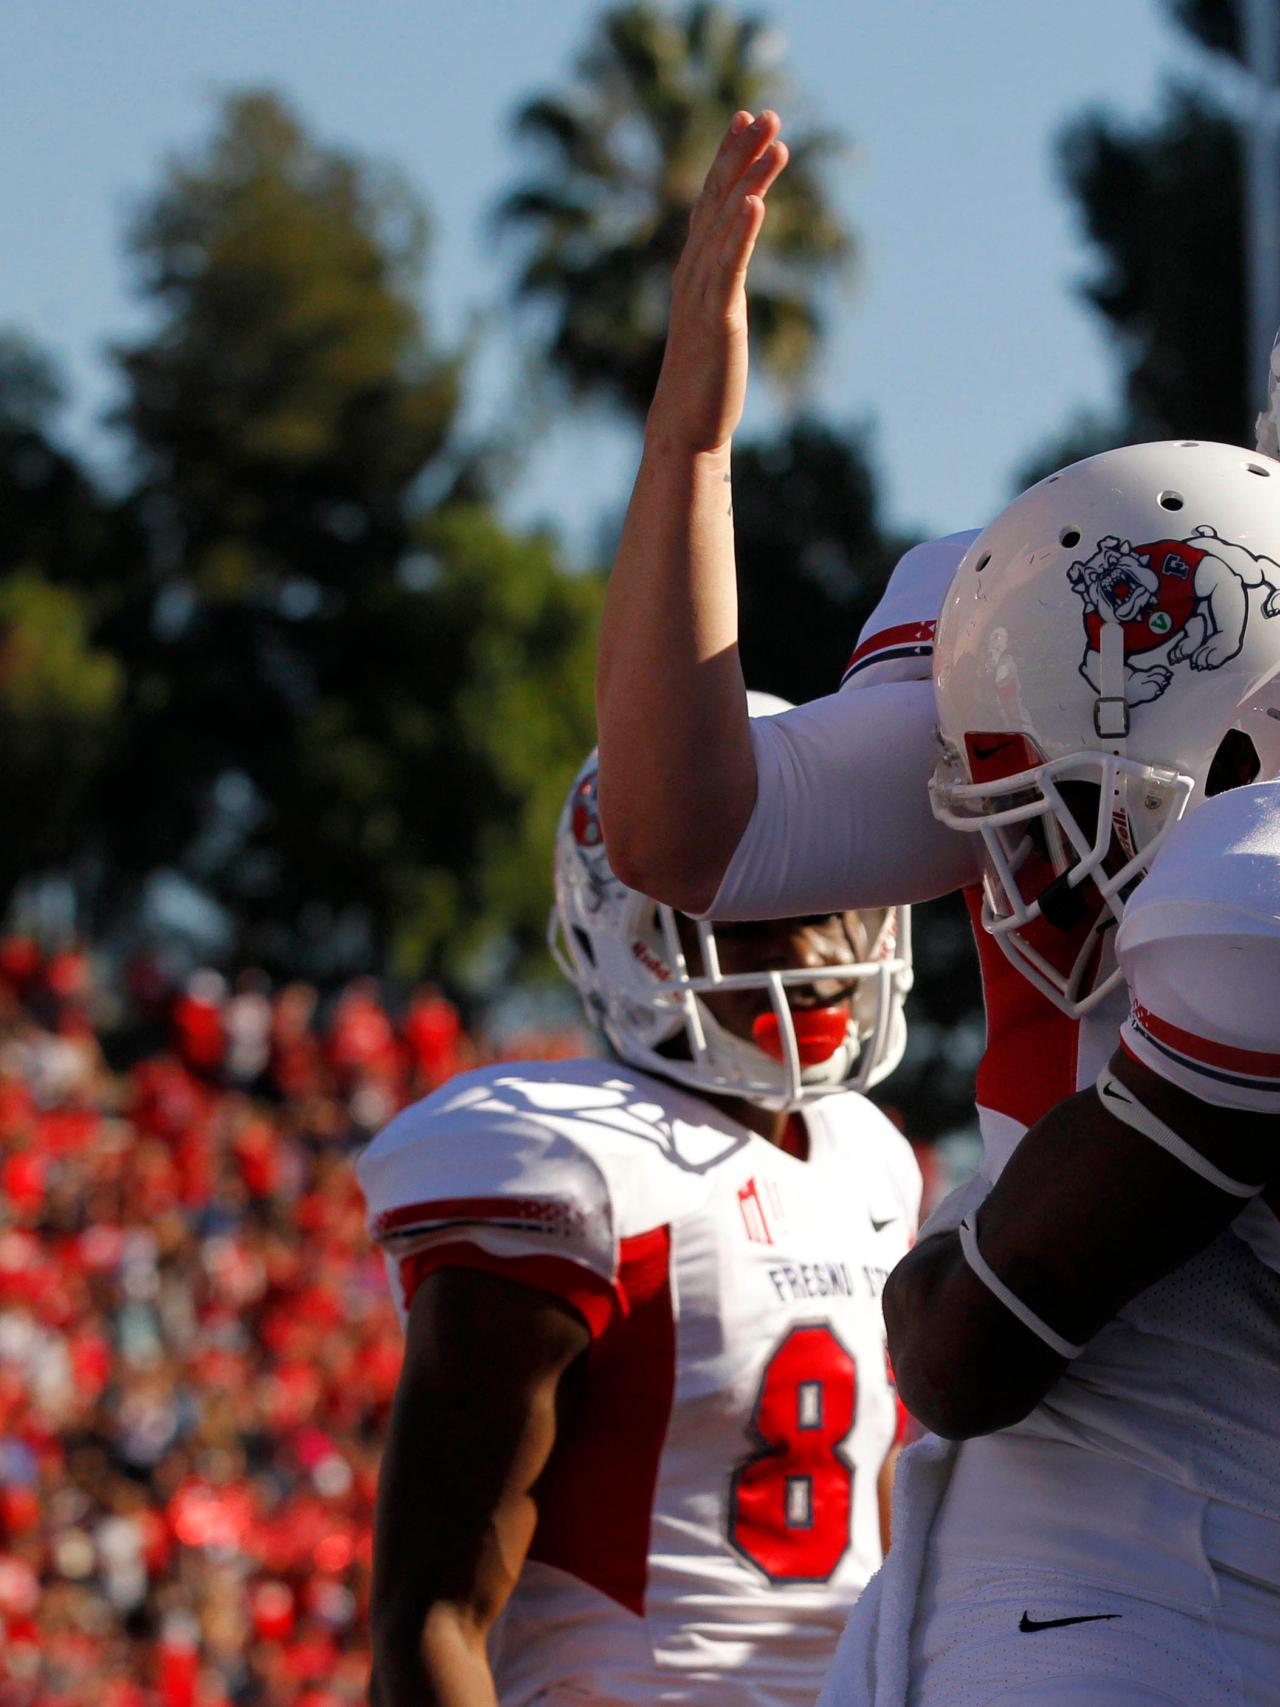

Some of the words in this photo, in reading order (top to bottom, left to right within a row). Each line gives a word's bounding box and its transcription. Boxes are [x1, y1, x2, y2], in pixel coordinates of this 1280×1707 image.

[1162, 553, 1190, 580] F
[1150, 613, 1169, 631] V
[725, 1314, 897, 1588] 8
